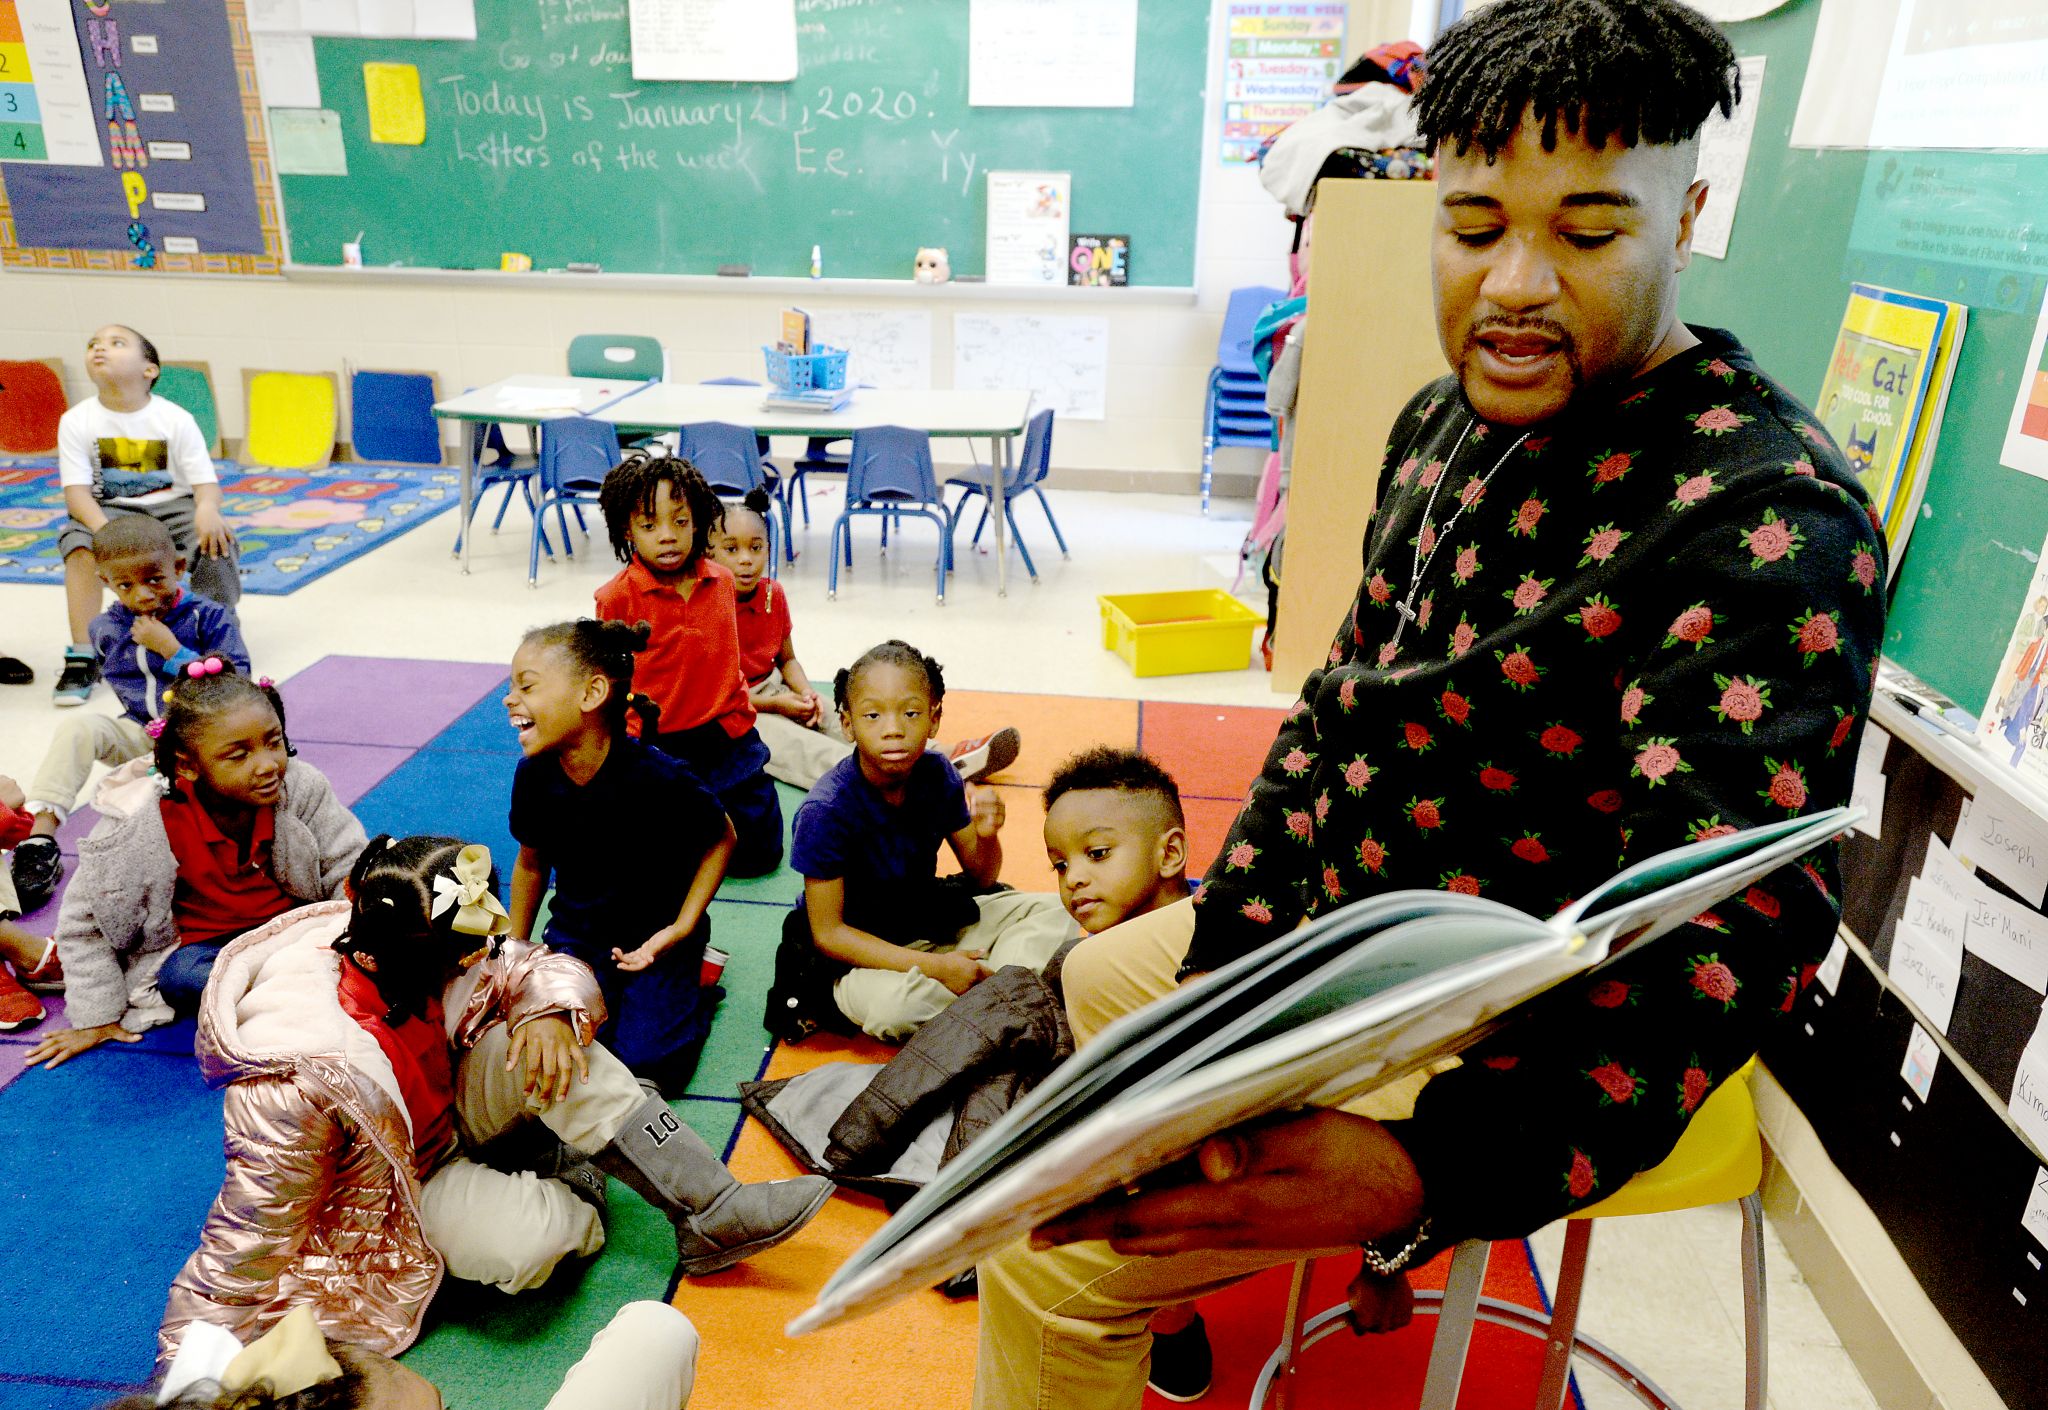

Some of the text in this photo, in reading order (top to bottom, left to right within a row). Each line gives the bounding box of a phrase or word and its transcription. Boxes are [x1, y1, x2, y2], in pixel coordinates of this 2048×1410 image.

[1263, 19, 1311, 33] Sunday
[1257, 41, 1313, 57] Monday
[1258, 63, 1309, 75] Tuesday
[1246, 84, 1319, 96] Wednesday
[4, 92, 18, 112] 3
[438, 74, 548, 142] Today
[563, 95, 594, 121] is
[609, 90, 741, 149] January
[14, 131, 26, 151] 4
[453, 129, 551, 169] Letters
[616, 142, 660, 172] the
[1071, 246, 1128, 277] ONE
[1834, 337, 1908, 396] Pete Cat
[1853, 389, 1873, 406] COOL
[1873, 394, 1891, 410] FOR
[1862, 408, 1894, 427] SCHOOL
[1980, 814, 2036, 869] Joseph
[1971, 898, 2033, 951] Jer'Mani
